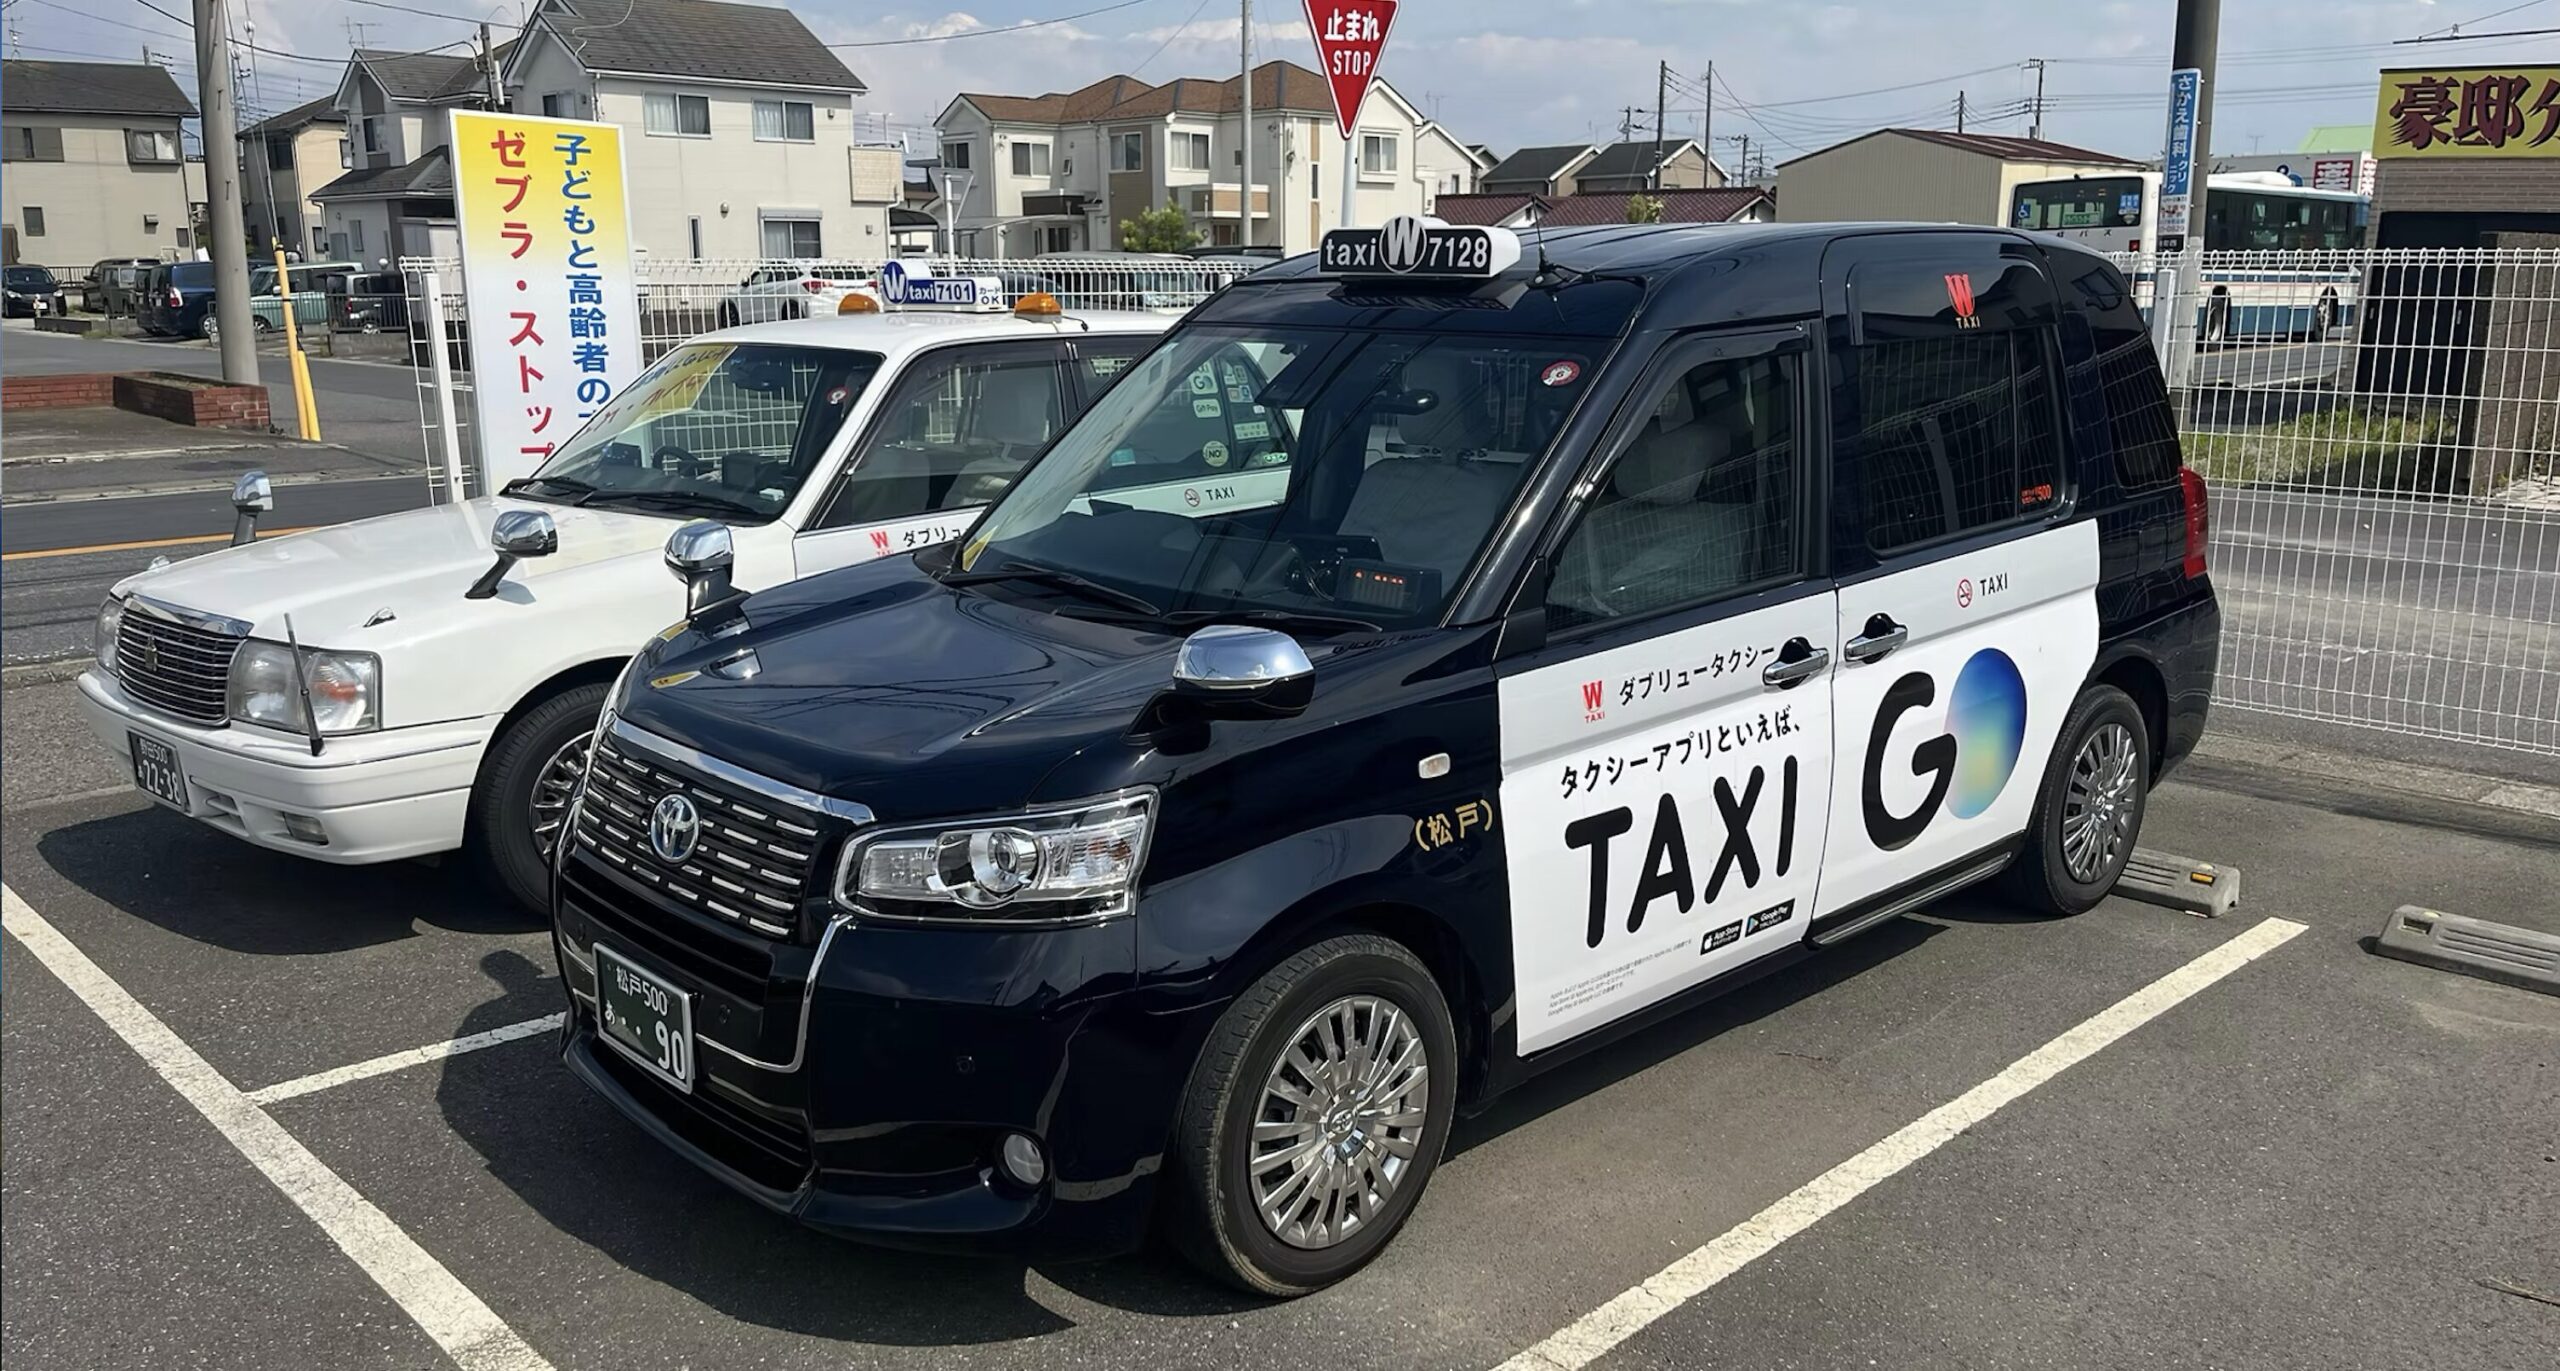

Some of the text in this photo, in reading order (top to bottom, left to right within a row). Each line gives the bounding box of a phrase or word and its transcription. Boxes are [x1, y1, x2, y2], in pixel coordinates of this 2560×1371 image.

[1323, 8, 1381, 41] 止まれ
[1333, 49, 1372, 76] STOP
[2171, 74, 2194, 158] さかえ歯科
[2315, 161, 2351, 189] 薬
[1326, 238, 1377, 267] taxi
[1429, 236, 1489, 268] 7128
[554, 133, 612, 419] 子どもと高齢者の
[909, 284, 935, 300] taxi
[937, 283, 971, 301] 7101
[981, 295, 1000, 305] OK
[1956, 316, 1981, 329] TAXI
[1205, 486, 1235, 501] TAXI
[870, 531, 889, 549] W
[1980, 572, 2008, 597] TAXI
[1619, 646, 1775, 706] ダブリュータクシー
[1582, 680, 1603, 710] W
[1585, 711, 1606, 724] TAXI
[1561, 704, 1800, 800] タクシーアプリといえば、
[1565, 647, 2028, 949] TAXI GO
[616, 965, 668, 1017] 松戸500
